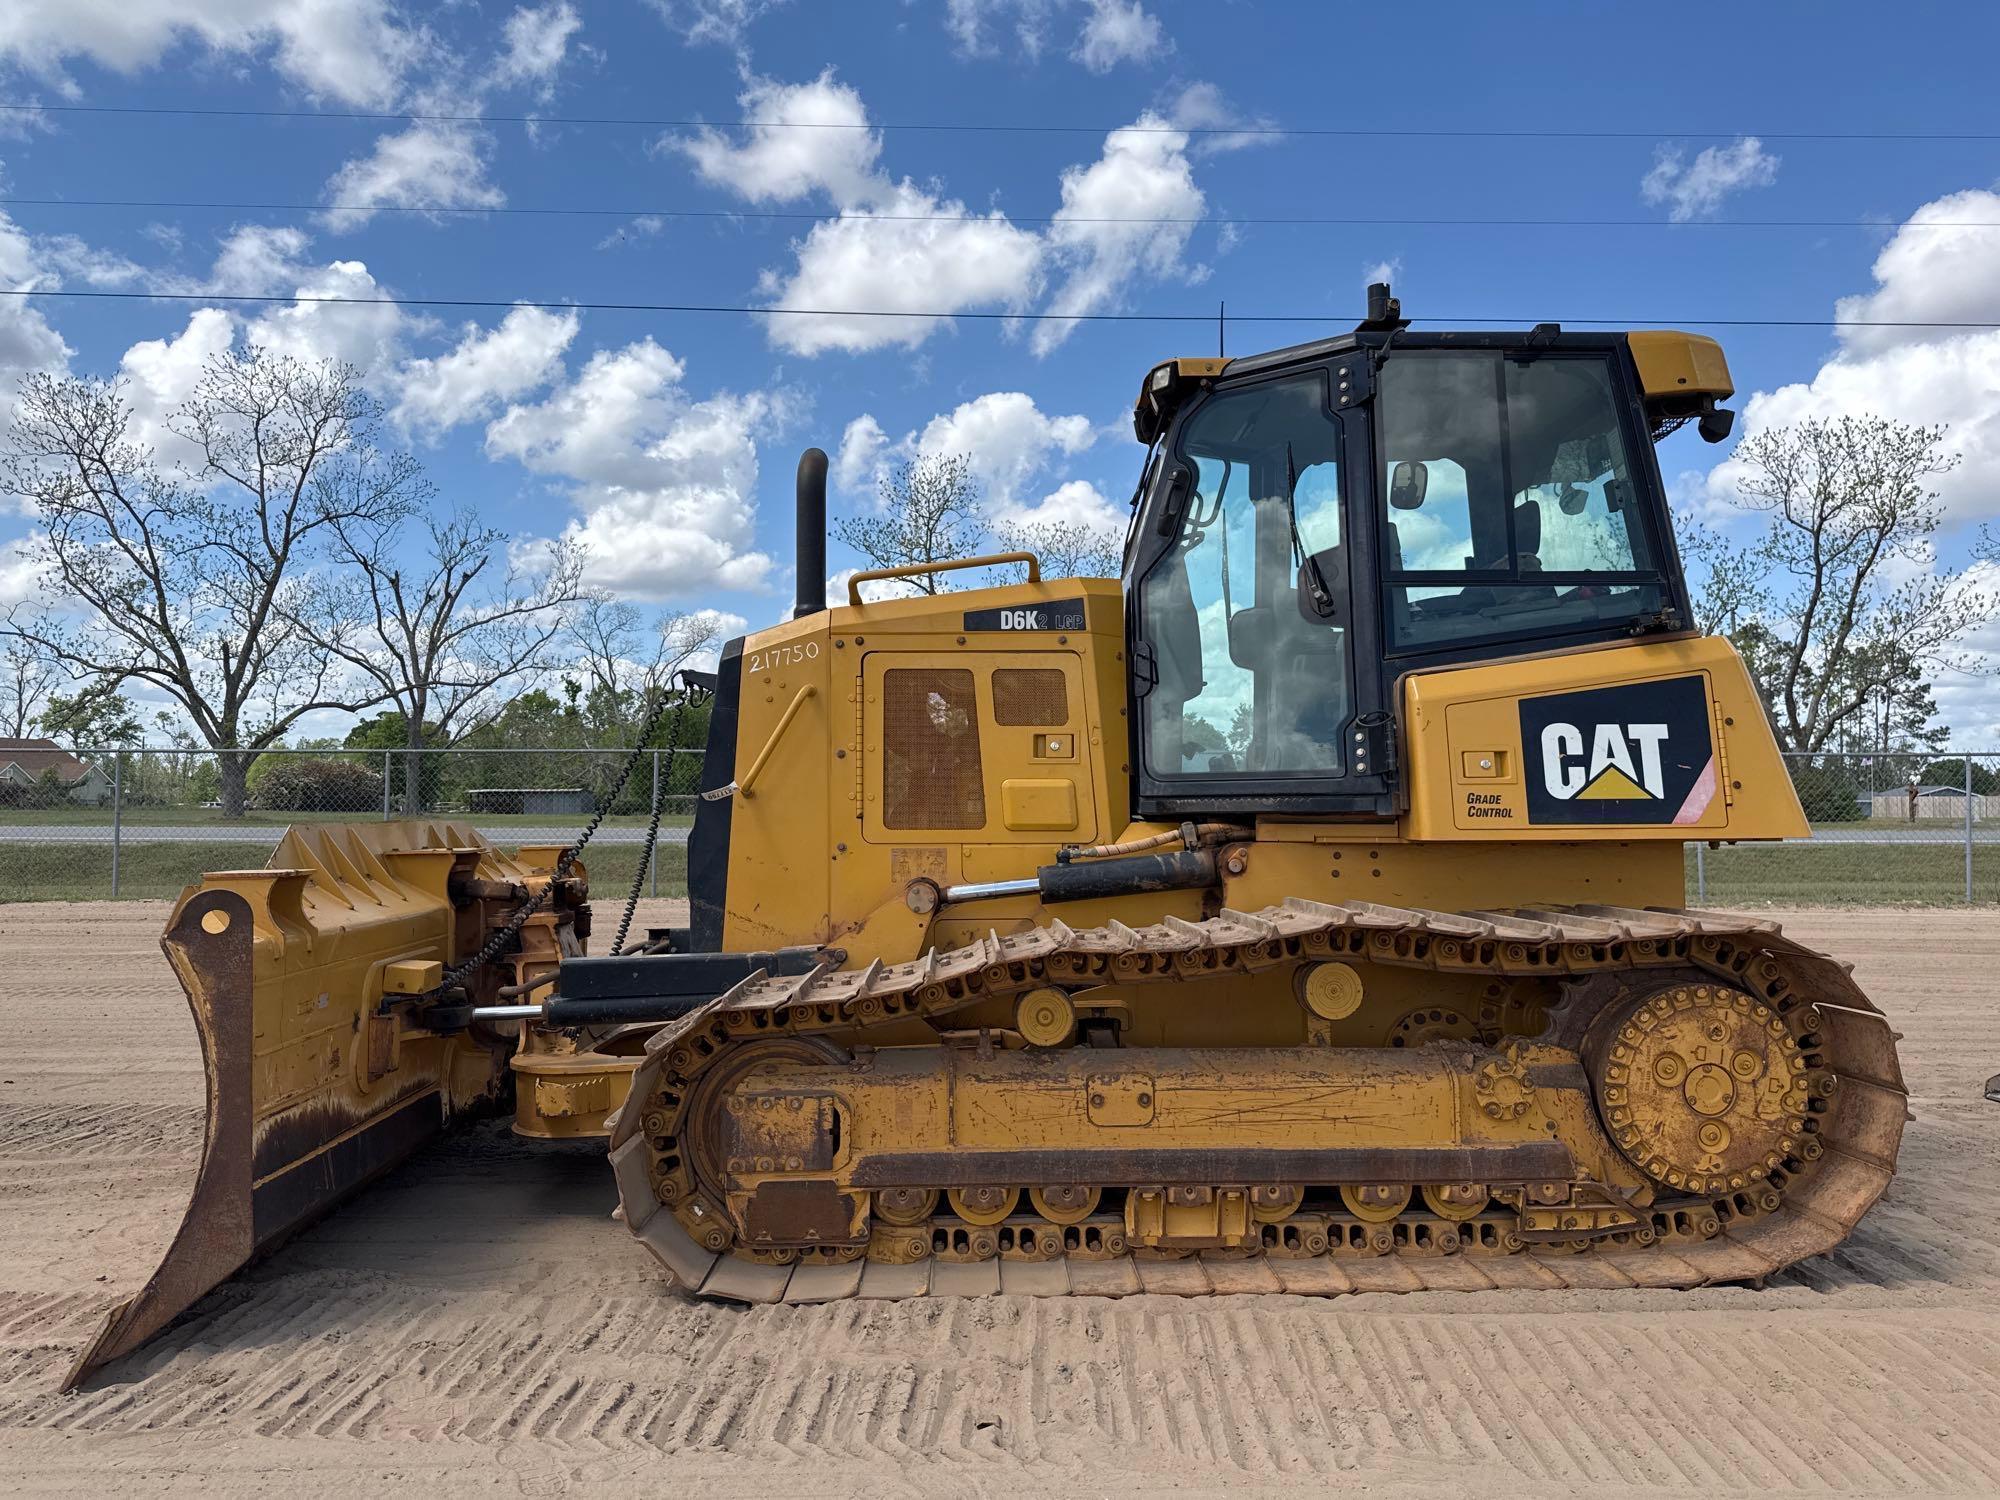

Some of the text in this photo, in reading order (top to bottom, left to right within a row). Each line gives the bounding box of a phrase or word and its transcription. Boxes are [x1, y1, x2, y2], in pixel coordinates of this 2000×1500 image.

[1055, 614, 1083, 630] LGP
[749, 641, 819, 673] 217750
[1541, 722, 1669, 800] CAT
